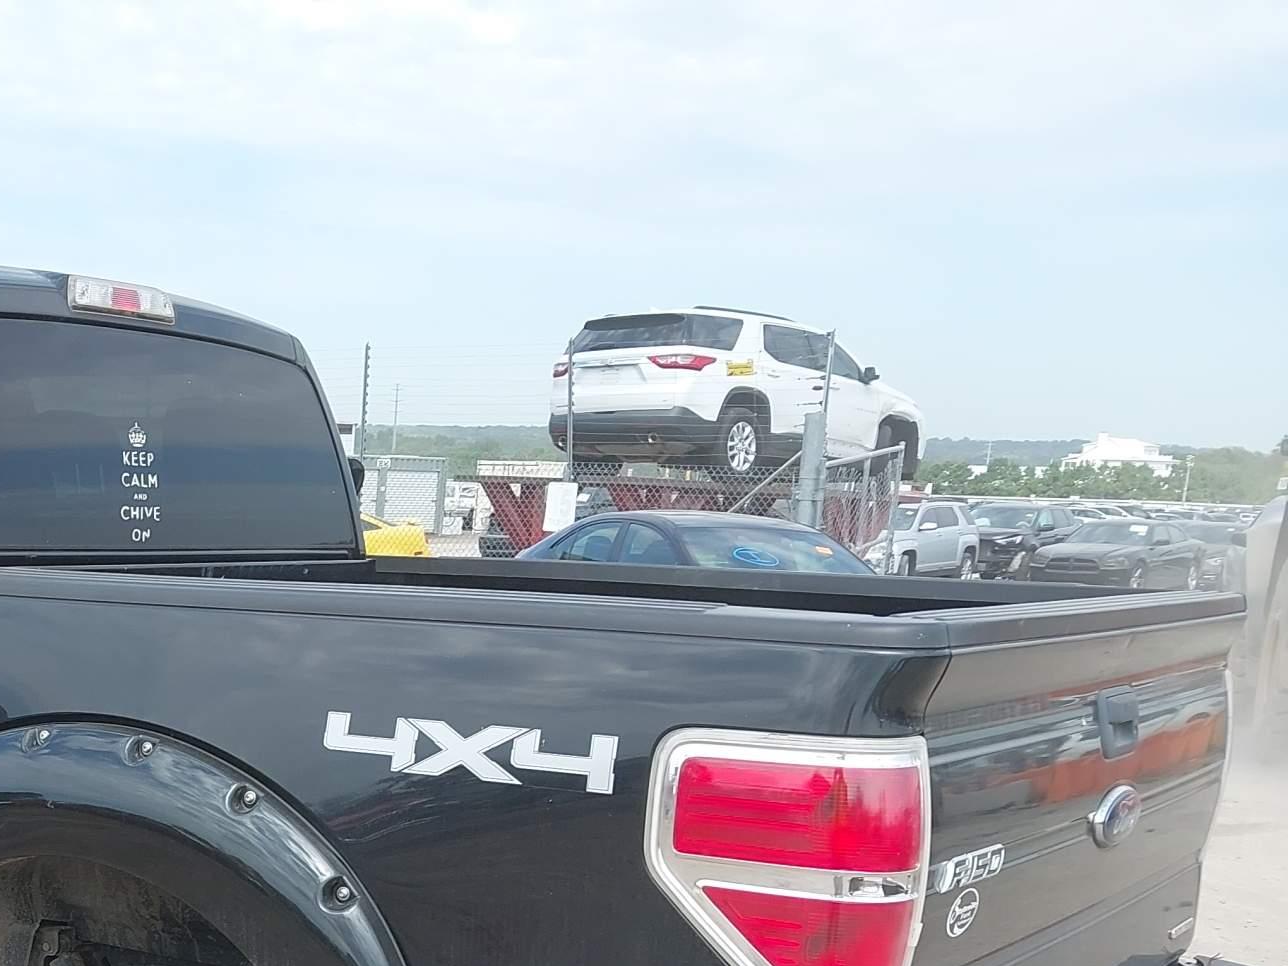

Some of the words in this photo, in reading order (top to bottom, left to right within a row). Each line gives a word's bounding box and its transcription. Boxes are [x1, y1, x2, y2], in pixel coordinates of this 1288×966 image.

[122, 451, 154, 467] KEEP
[121, 473, 158, 488] CALM
[133, 493, 148, 501] AND
[120, 505, 160, 521] CHIVE
[131, 528, 151, 542] ON
